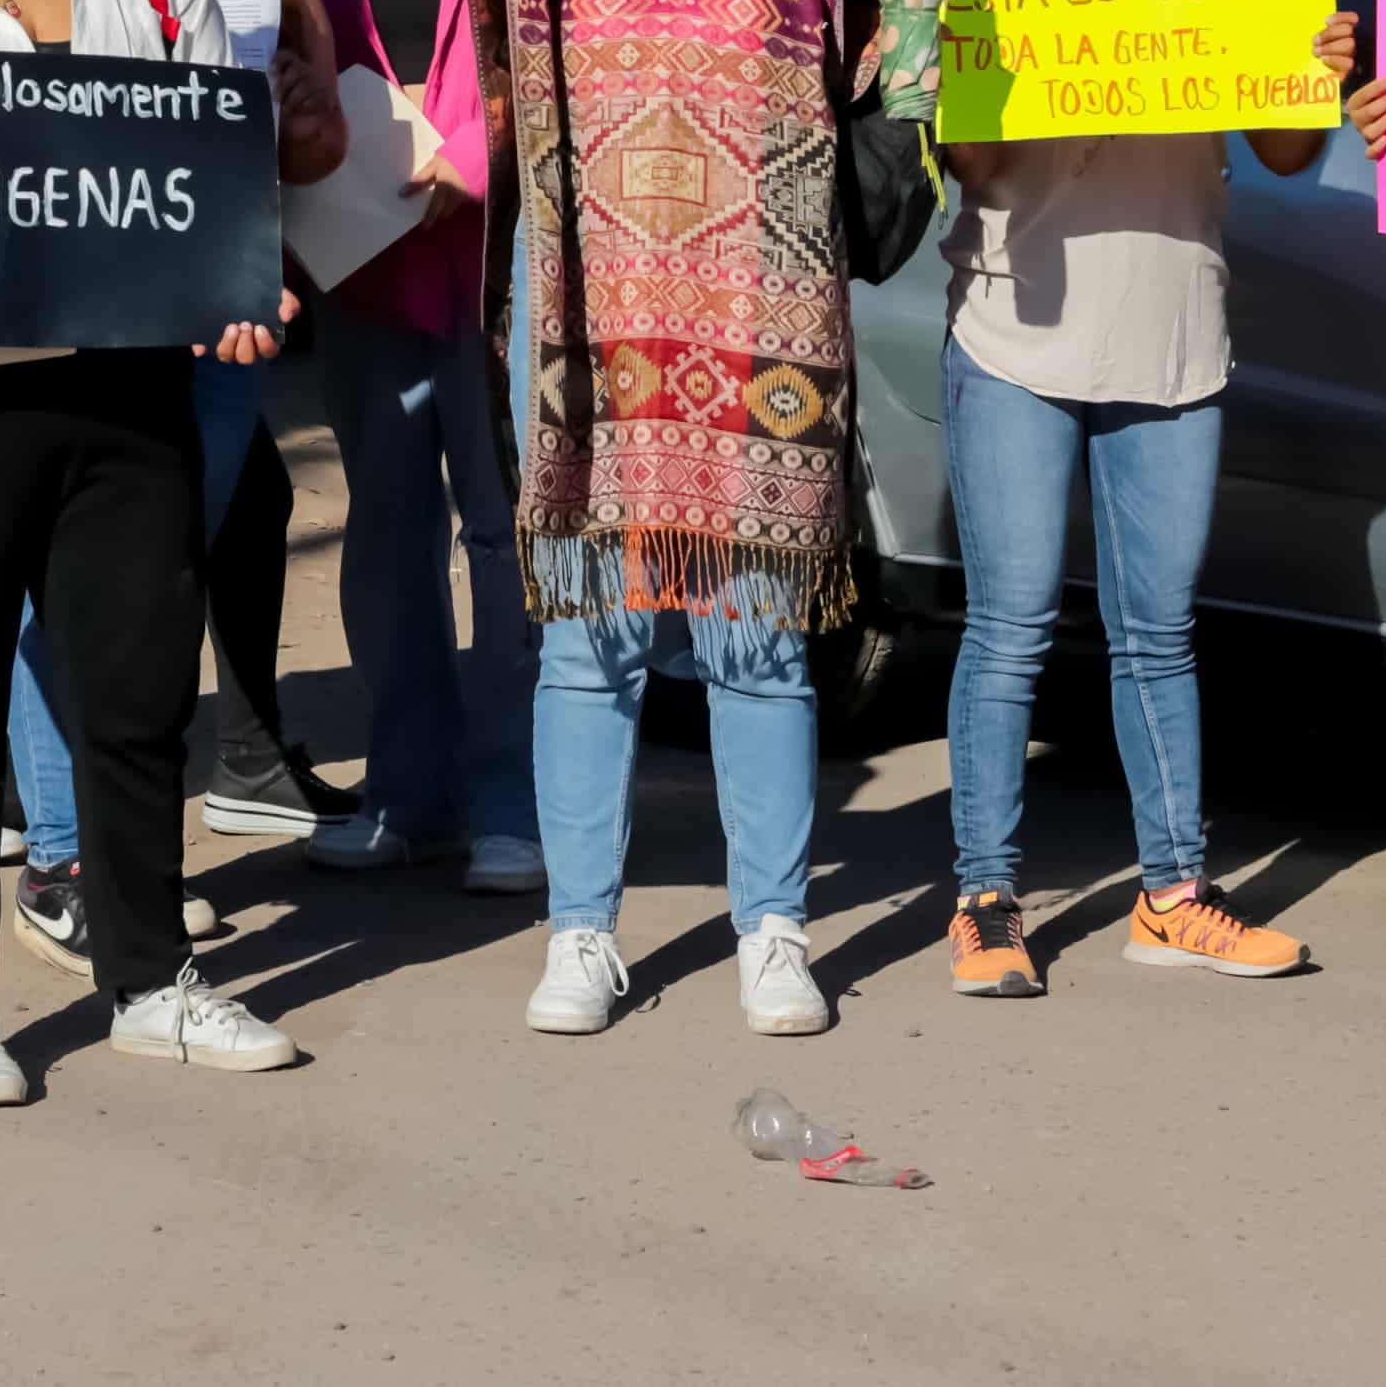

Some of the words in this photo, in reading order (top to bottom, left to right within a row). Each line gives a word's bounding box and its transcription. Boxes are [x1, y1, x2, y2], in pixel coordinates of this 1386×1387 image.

[941, 33, 1039, 73] TODA
[1055, 32, 1099, 66] LA
[1042, 77, 1147, 119] TODOS
[1162, 75, 1221, 112] LOS
[1235, 72, 1338, 112] PUEBLOS
